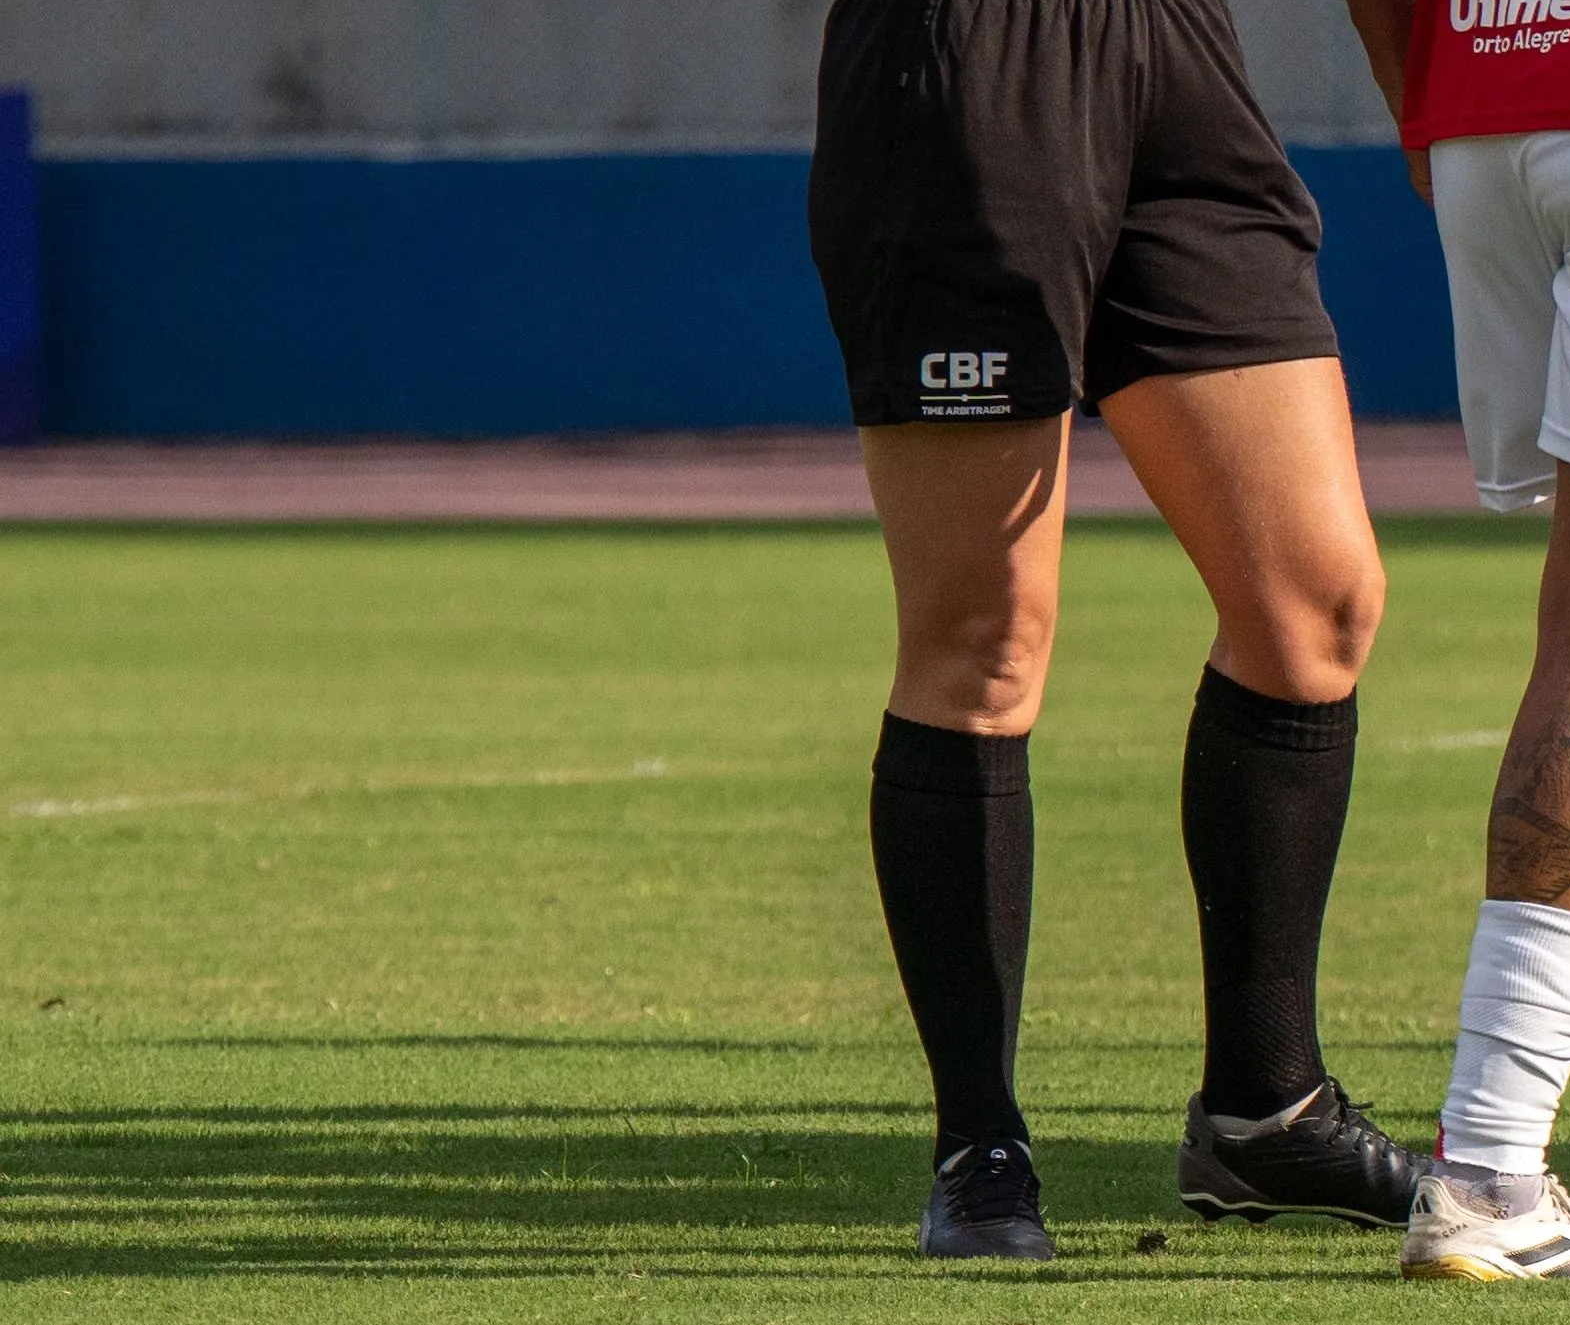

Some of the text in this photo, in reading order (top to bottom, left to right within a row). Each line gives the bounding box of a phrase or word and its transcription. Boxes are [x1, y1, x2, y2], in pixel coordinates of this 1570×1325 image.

[1473, 32, 1511, 55] orto
[921, 352, 1009, 389] CBF
[921, 404, 1011, 416] TIME ARBITRAGEM
